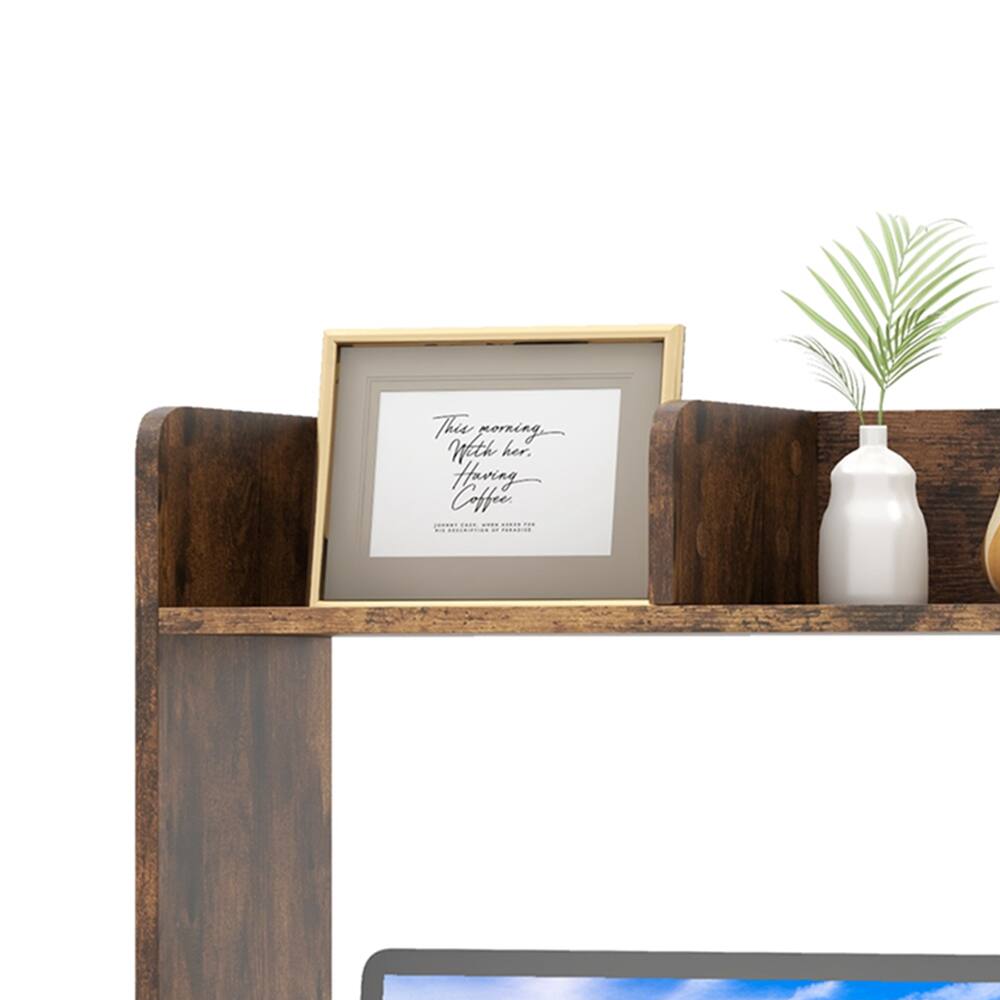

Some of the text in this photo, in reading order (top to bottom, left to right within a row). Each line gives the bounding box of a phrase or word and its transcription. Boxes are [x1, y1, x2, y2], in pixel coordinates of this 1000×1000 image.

[432, 413, 474, 440] This
[447, 433, 532, 465] With her.
[451, 461, 542, 492] Having
[450, 484, 513, 513] Coffee.
